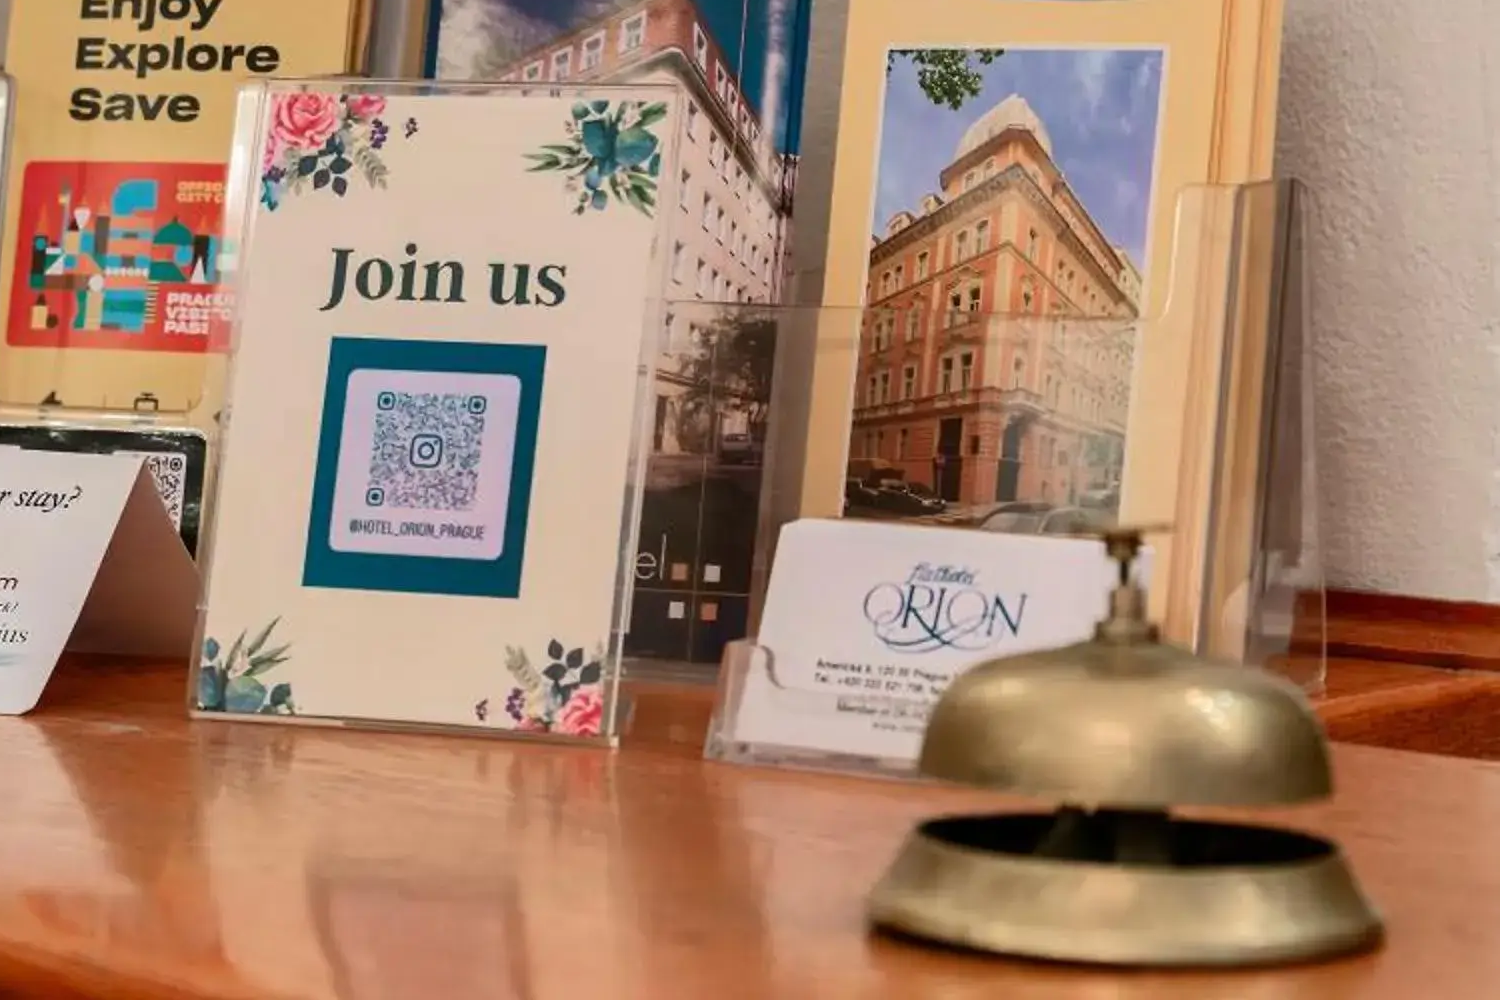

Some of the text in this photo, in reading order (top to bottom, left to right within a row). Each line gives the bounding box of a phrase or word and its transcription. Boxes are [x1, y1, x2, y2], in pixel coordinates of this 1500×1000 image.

[74, 36, 280, 79] Explore
[68, 87, 201, 123] Save
[317, 242, 568, 312] Join us
[13, 484, 83, 513] stay?
[349, 518, 485, 541] @HOTEL_ORION_PRAGUE
[863, 582, 1028, 652] ORION
